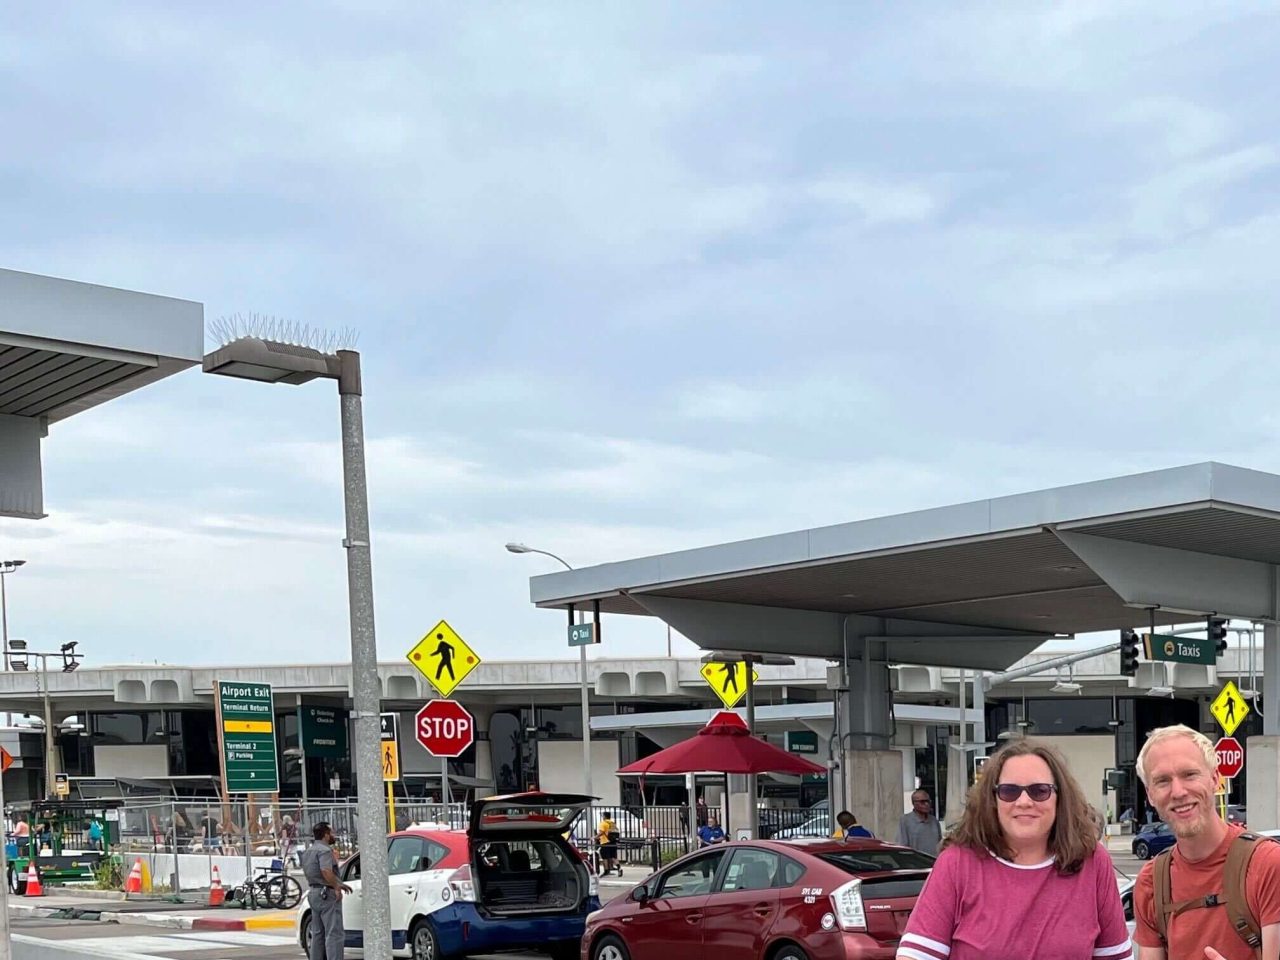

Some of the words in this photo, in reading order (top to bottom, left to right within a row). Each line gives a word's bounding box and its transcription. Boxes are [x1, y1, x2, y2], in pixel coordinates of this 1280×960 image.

[1177, 643, 1200, 657] Taxis
[222, 686, 251, 698] Airport
[254, 688, 269, 697] Exit
[223, 703, 248, 711] Terminal
[250, 704, 268, 712] Return
[420, 717, 468, 739] STOP
[226, 742, 251, 750] Terminal
[235, 752, 253, 760] Parking
[1215, 750, 1241, 766] STOP
